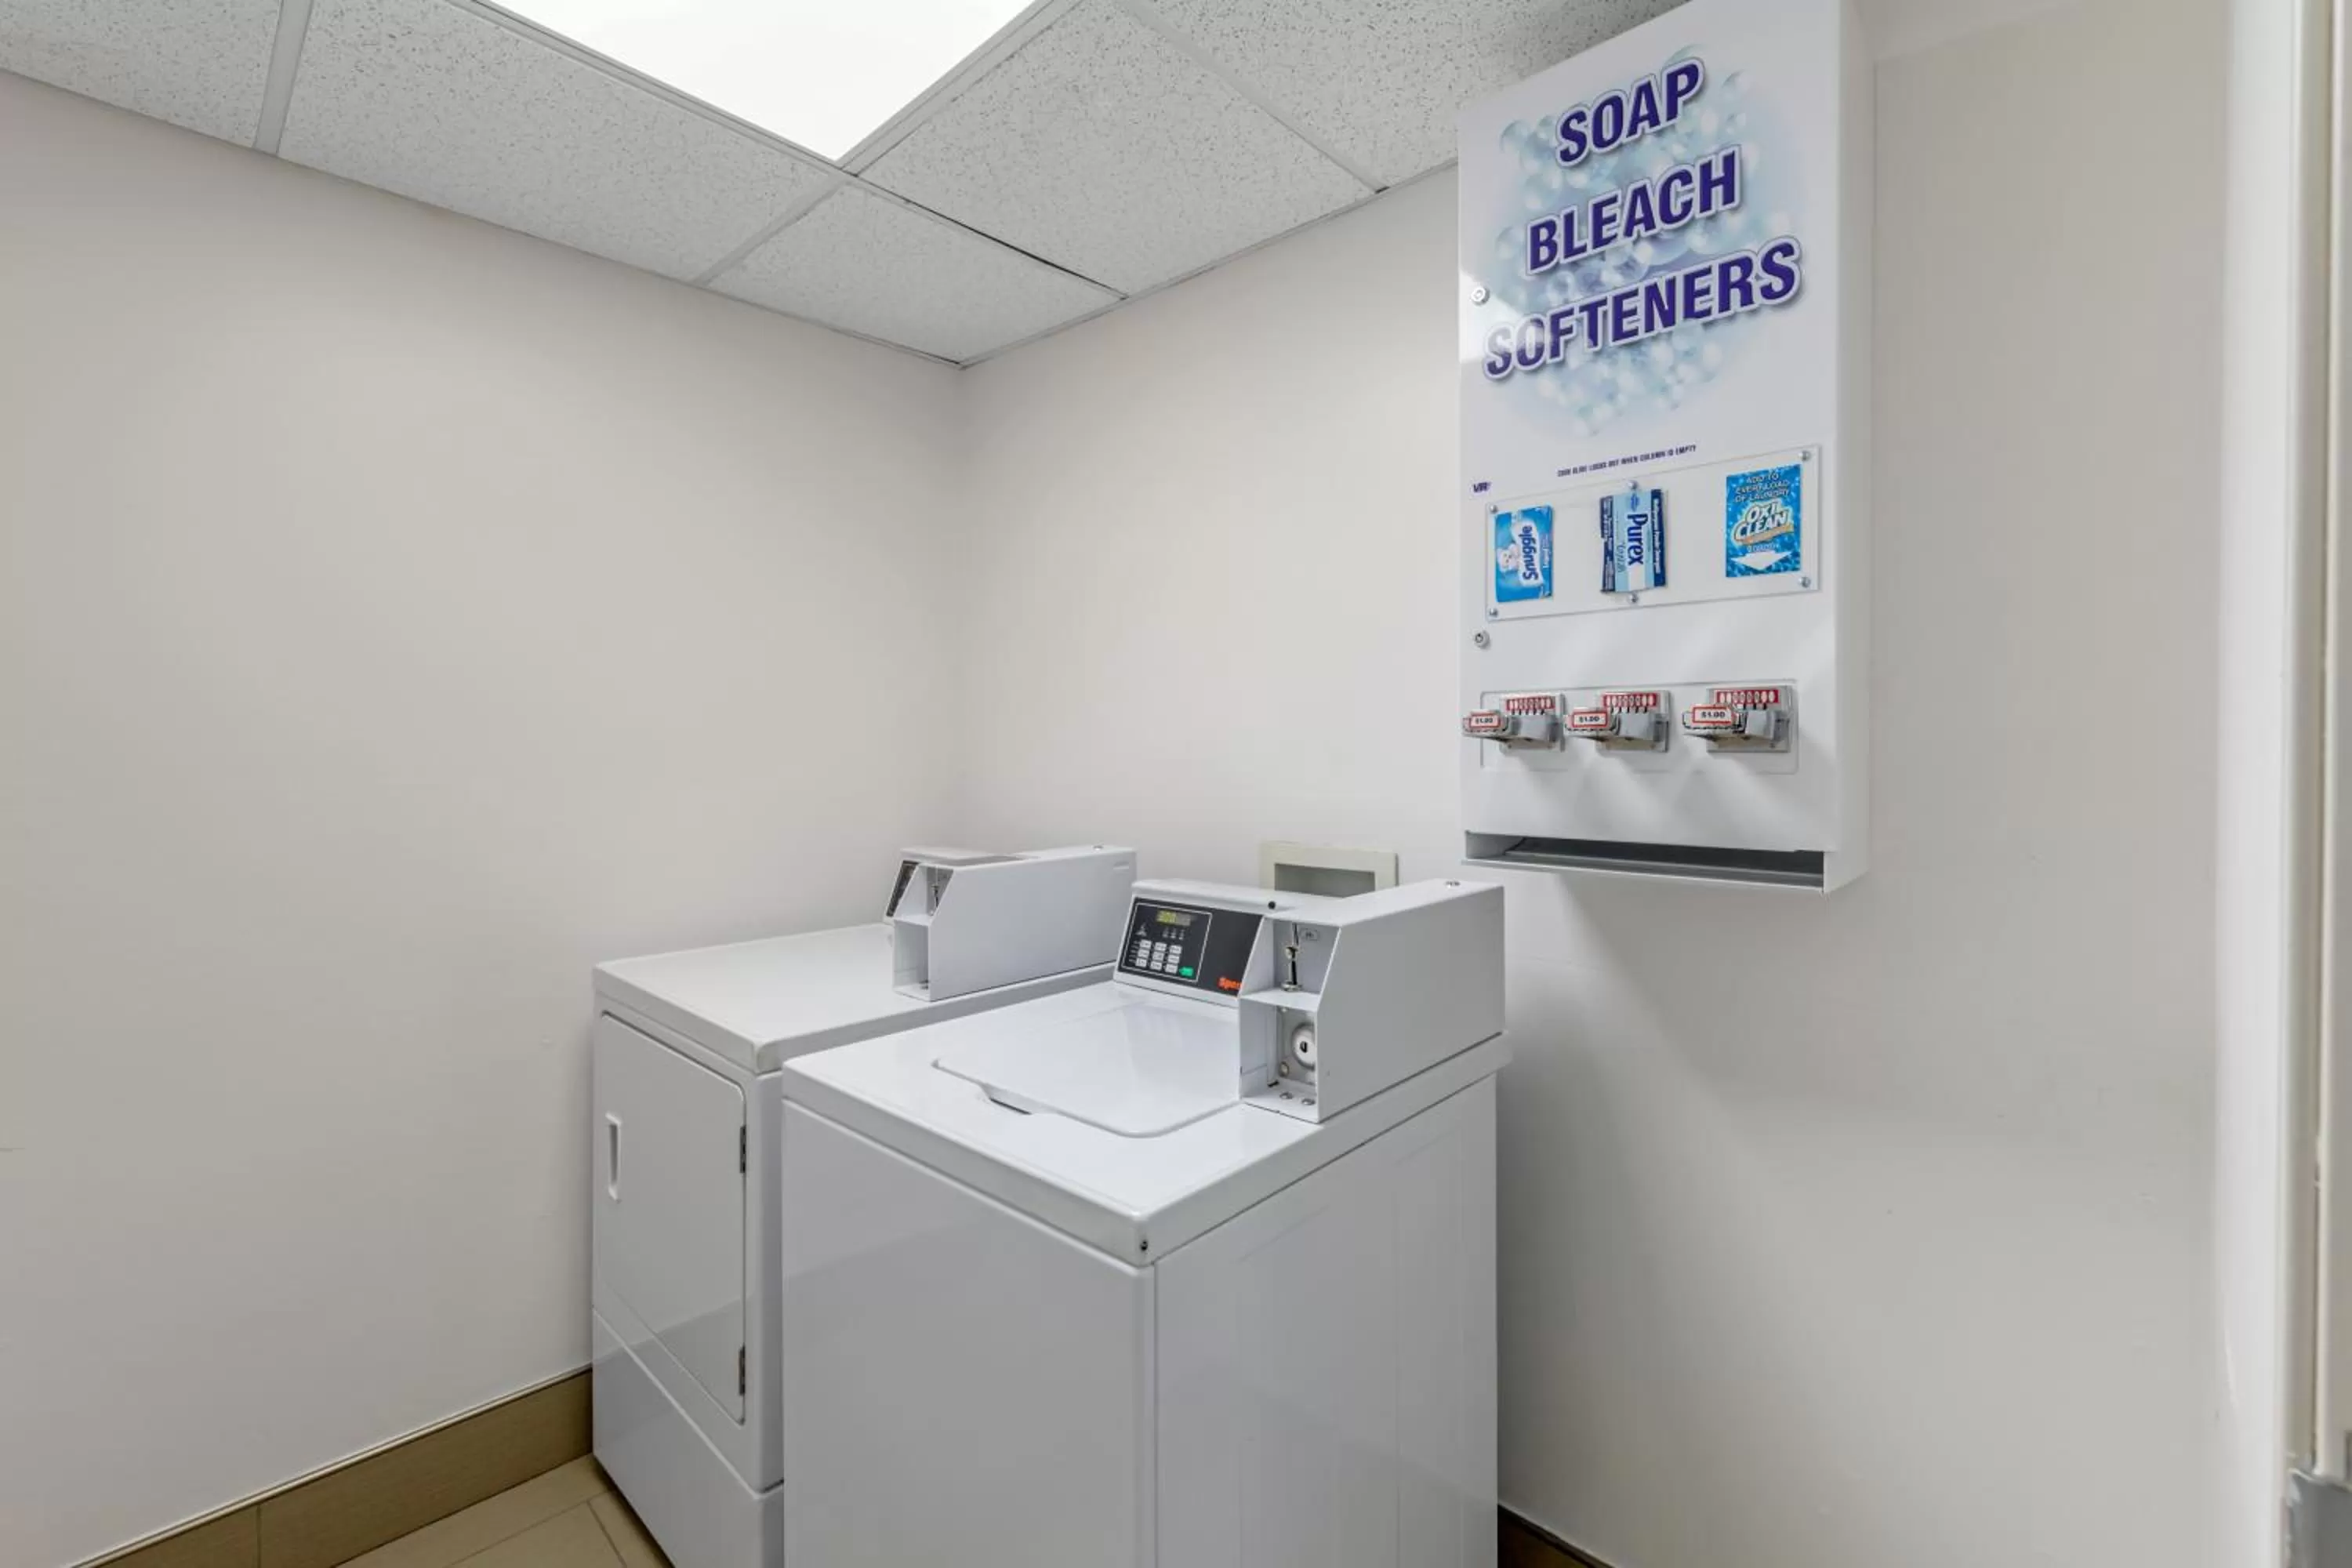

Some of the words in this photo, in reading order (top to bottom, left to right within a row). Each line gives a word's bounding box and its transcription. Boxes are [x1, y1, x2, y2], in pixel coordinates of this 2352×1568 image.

[1557, 60, 1702, 165] SOAP
[1528, 149, 1738, 272] BLEACH
[1486, 240, 1798, 377] SOFTENERS
[1675, 444, 1697, 456] EMPTY
[1734, 510, 1788, 541] CLEAN
[1746, 501, 1778, 524] OXI
[1519, 525, 1539, 581] Snuggle
[1627, 514, 1649, 566] Purex
